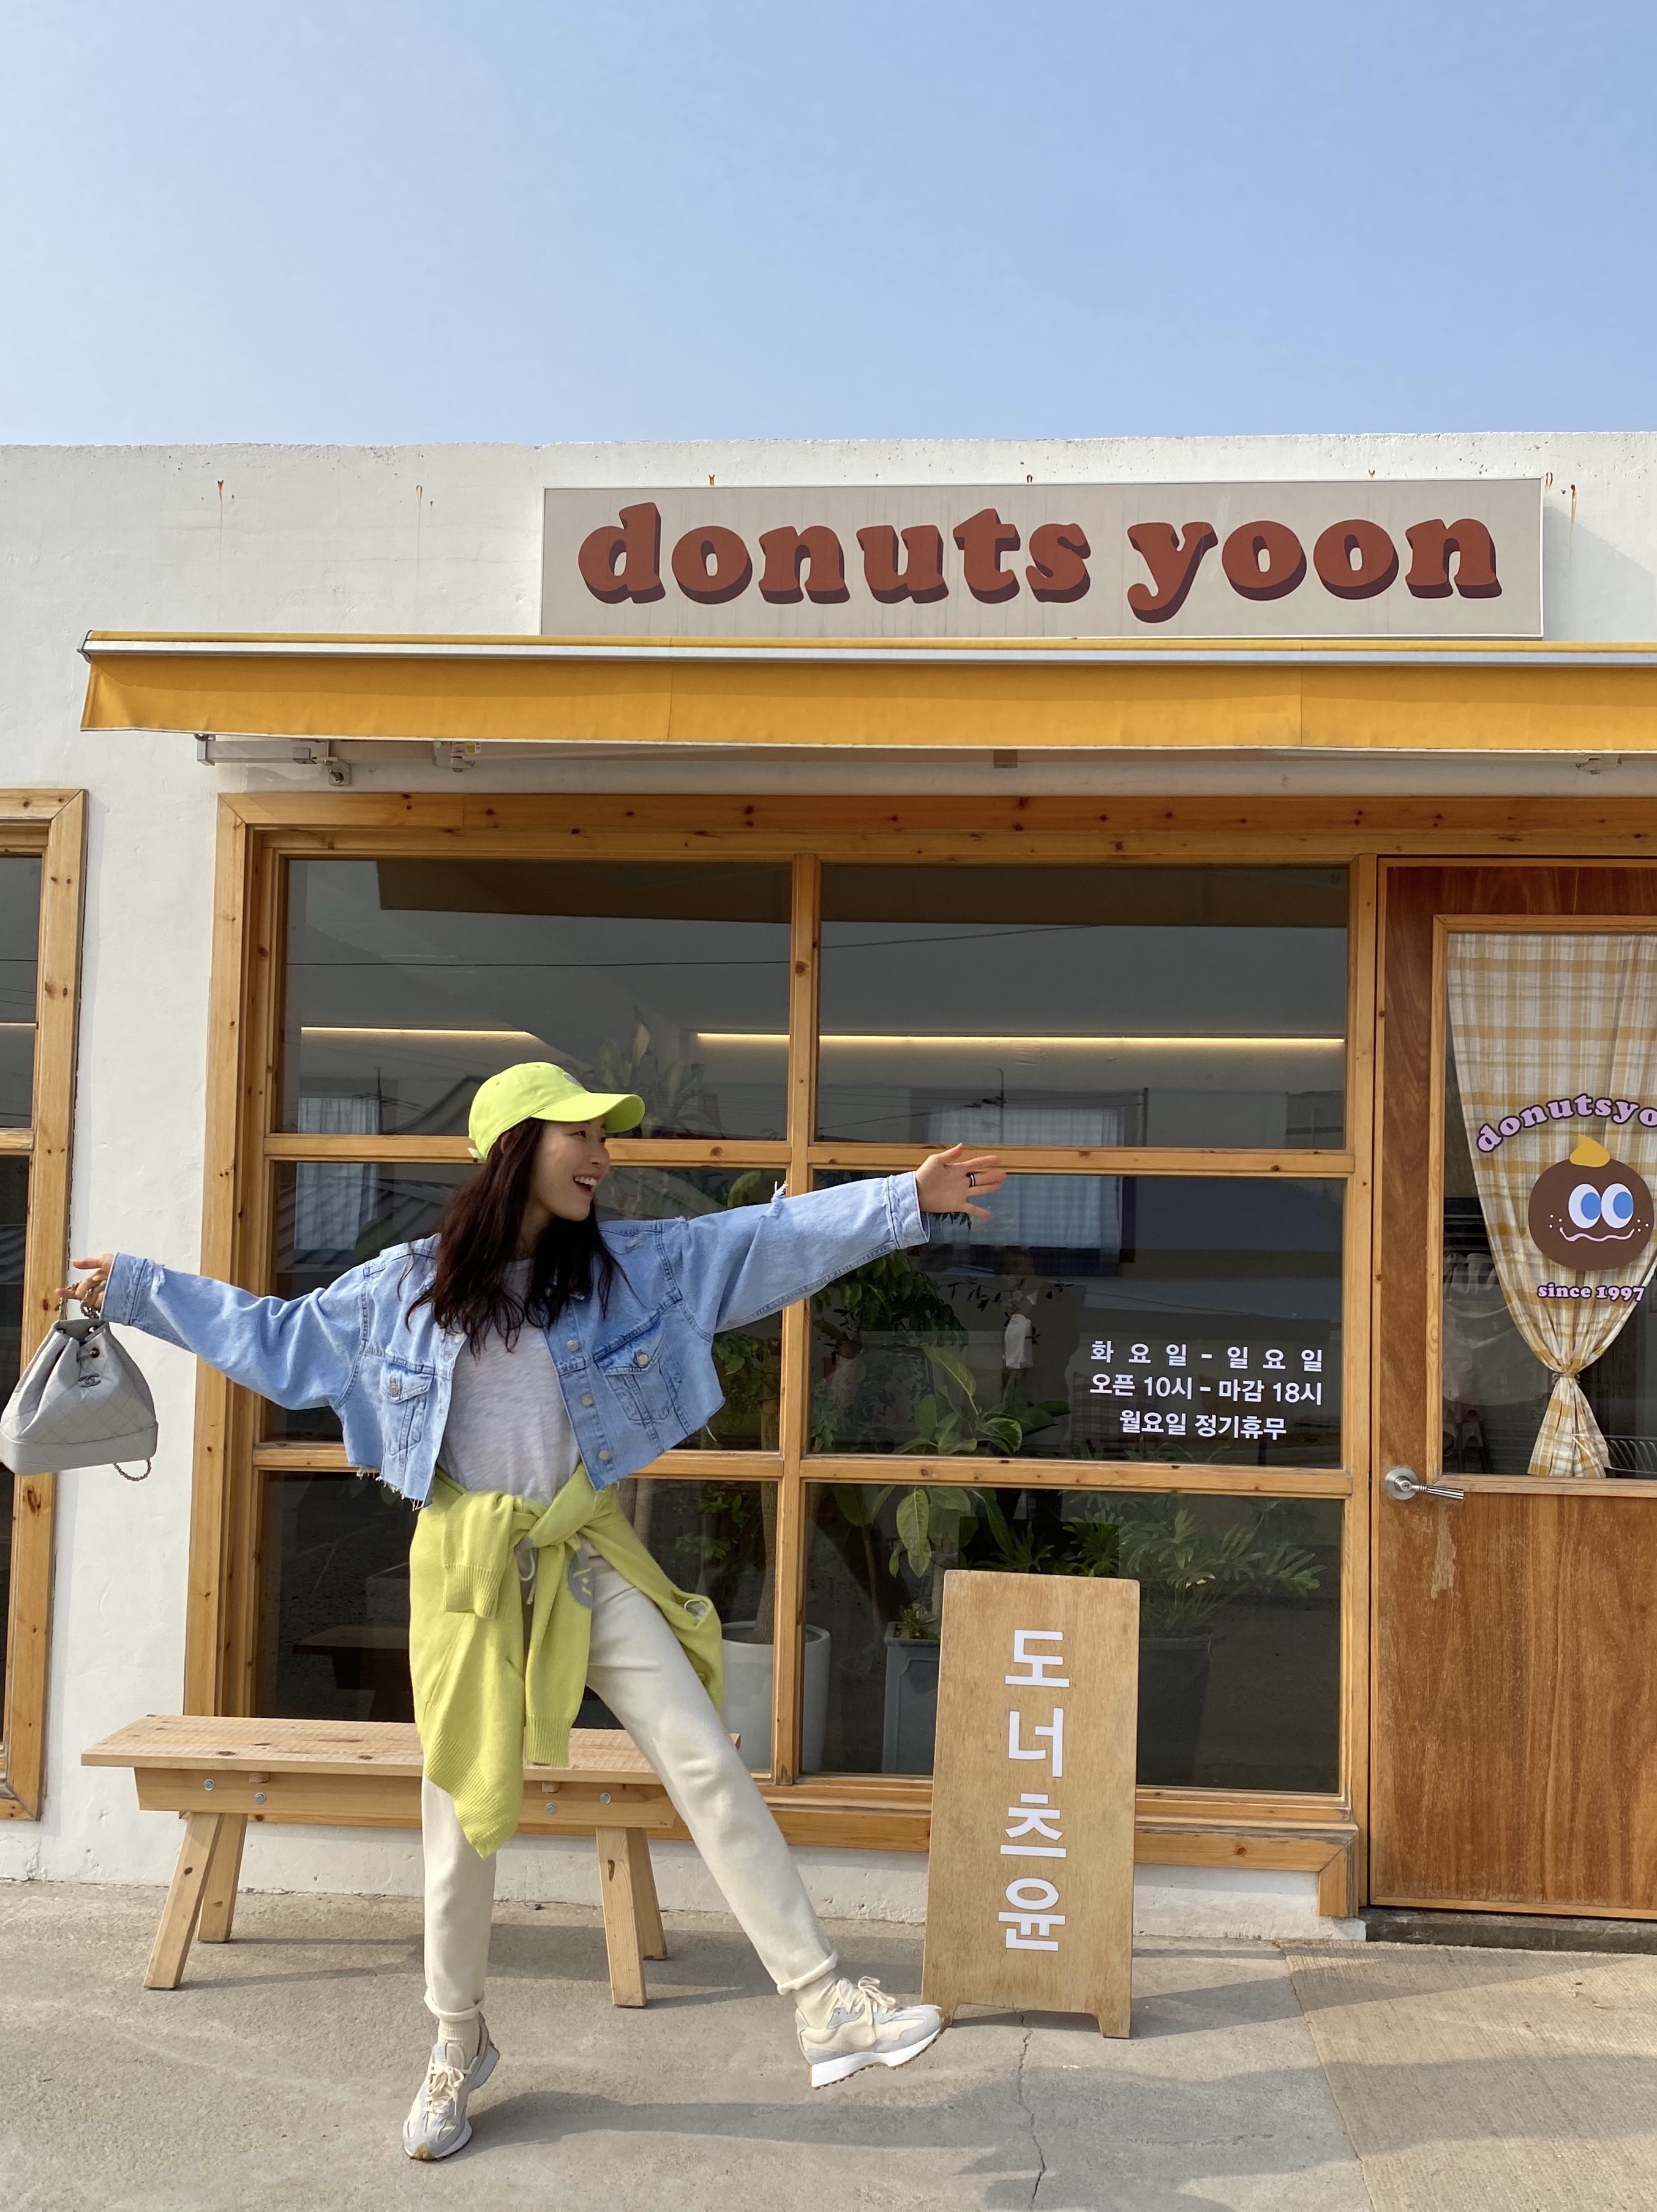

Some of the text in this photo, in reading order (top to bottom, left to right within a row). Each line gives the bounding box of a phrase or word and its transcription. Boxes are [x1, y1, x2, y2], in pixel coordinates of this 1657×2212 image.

[578, 502, 1503, 623] donuts yoon
[1538, 1282, 1645, 1301] since 1997
[1089, 1373, 1135, 1396] 오픈
[1144, 1376, 1192, 1400] 10시
[1219, 1379, 1265, 1402] 마감
[1272, 1382, 1322, 1405] 18시
[1119, 1410, 1287, 1440] 월요일 정기휴무
